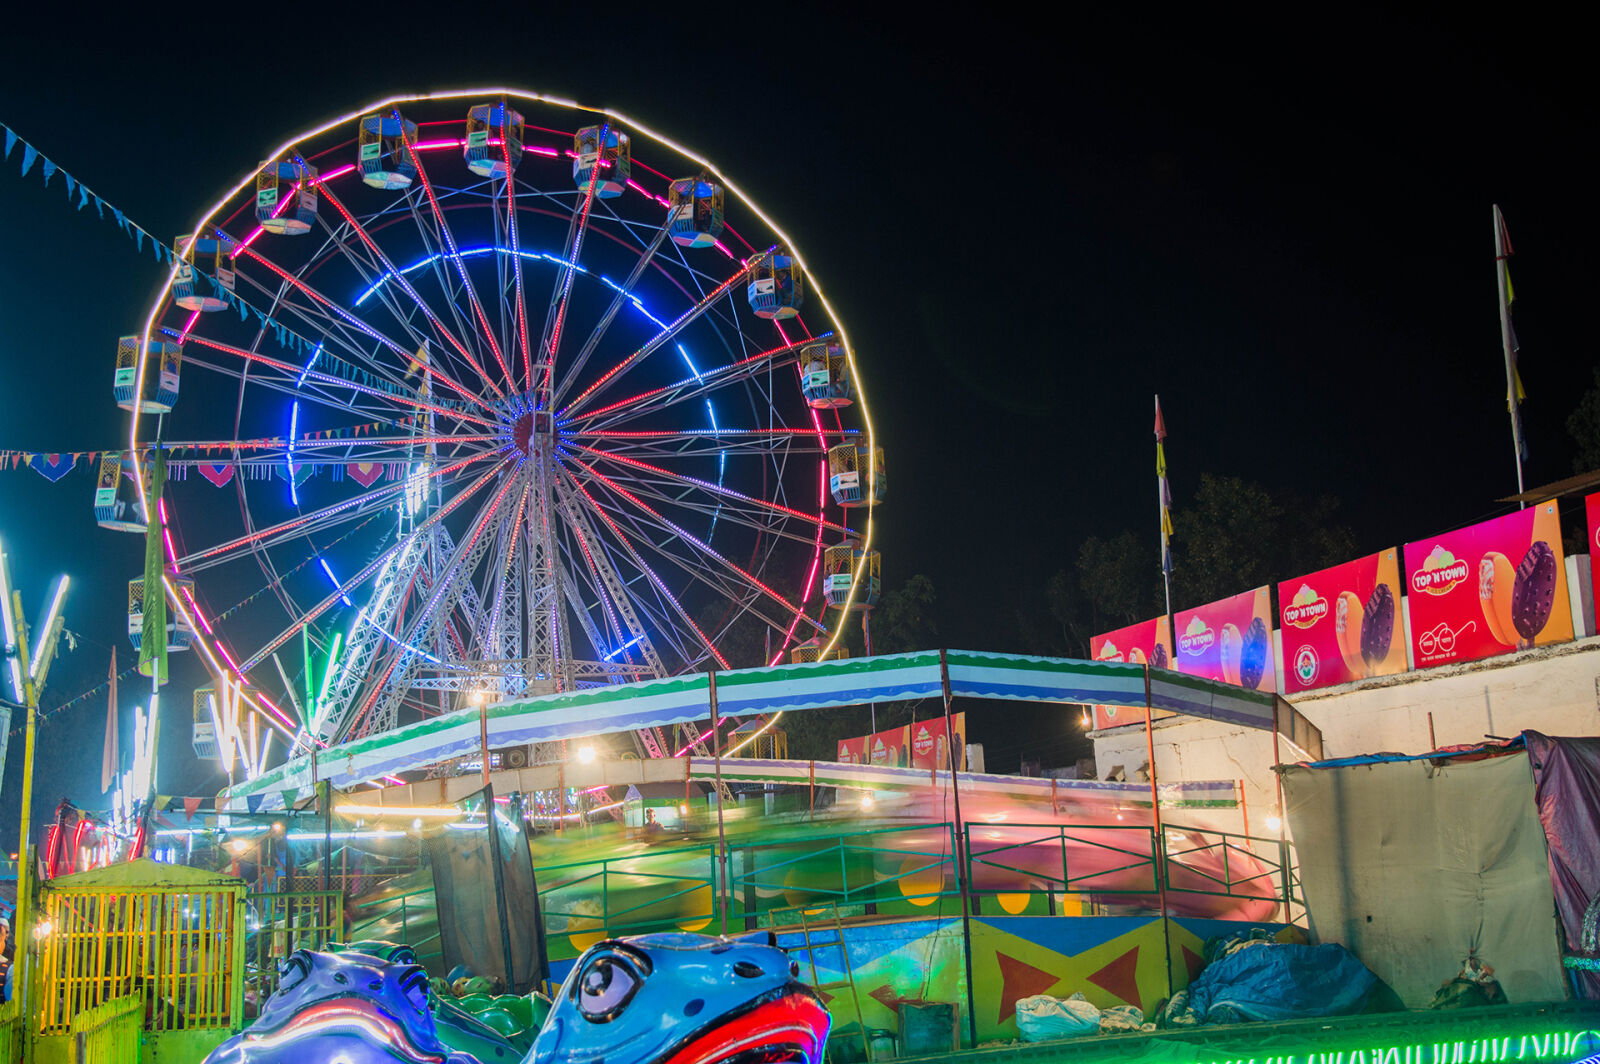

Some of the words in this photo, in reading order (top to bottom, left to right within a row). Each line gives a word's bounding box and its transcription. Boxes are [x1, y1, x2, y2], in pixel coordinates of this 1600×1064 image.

[1415, 574, 1431, 587] TOP
[1440, 565, 1465, 581] TOWN
[1286, 610, 1299, 621] TOP
[1306, 603, 1325, 616] TOWN
[1181, 639, 1191, 648] TOP
[1197, 633, 1212, 645] TOWN
